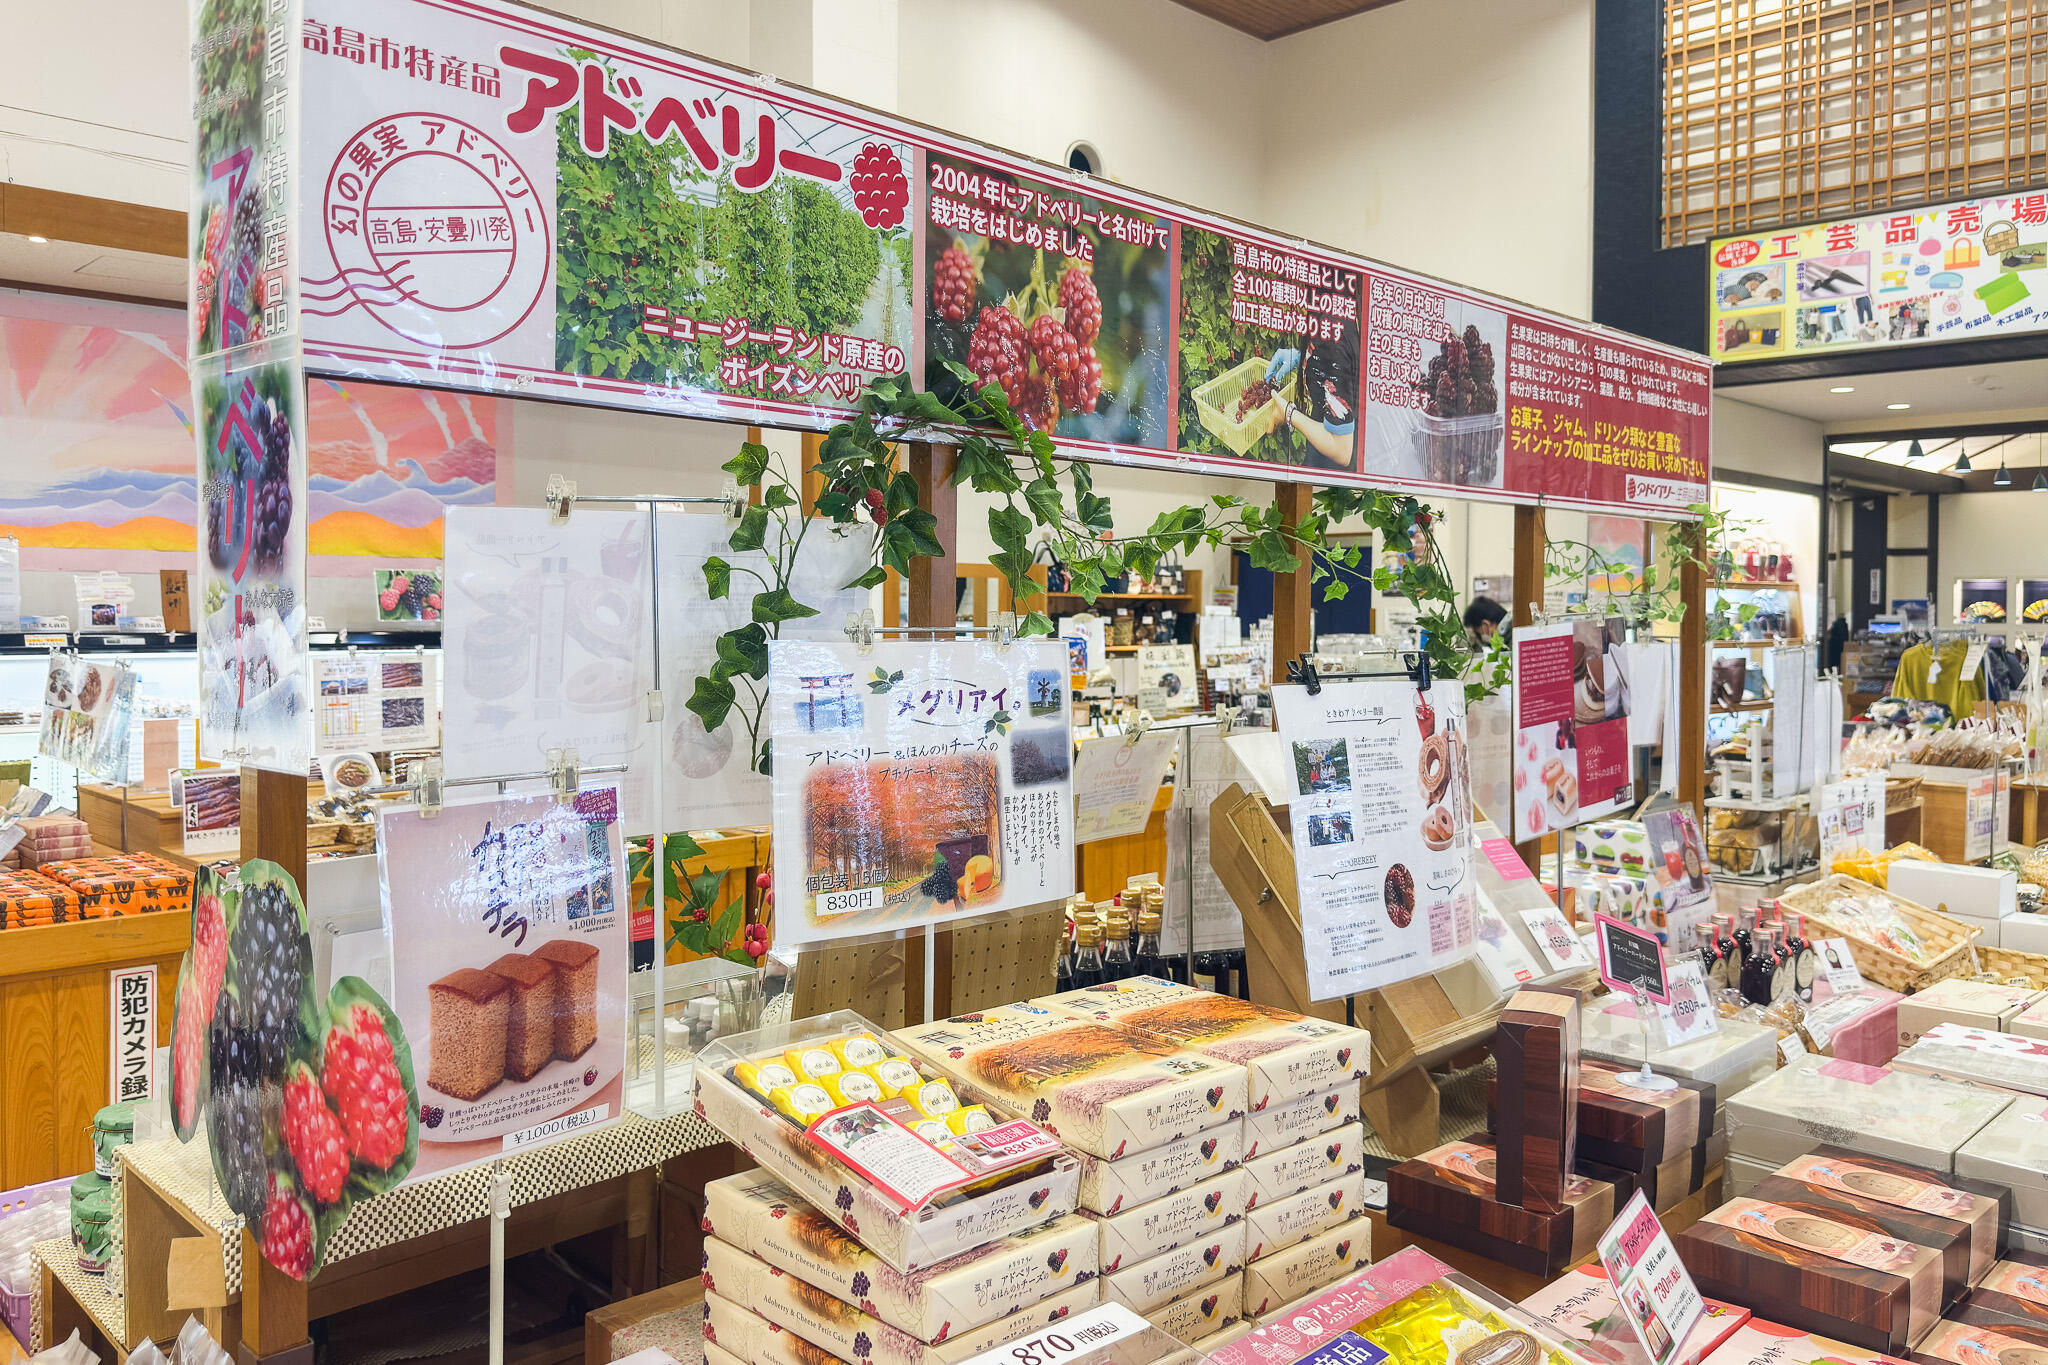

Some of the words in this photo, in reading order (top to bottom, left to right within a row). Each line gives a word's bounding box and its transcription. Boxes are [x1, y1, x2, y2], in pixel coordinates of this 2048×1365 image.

[303, 19, 502, 98] 高島市特産品
[498, 44, 843, 190] アドベリー
[331, 123, 408, 236] 幻の果実
[420, 120, 535, 233] アドベリー
[931, 164, 1169, 250] 2004年にアドベリーと名付けて
[931, 196, 1094, 261] 栽培をはじめました
[370, 216, 511, 245] 高島・安曇川発
[1233, 243, 1357, 293] 高島市の特産品として
[1232, 271, 1357, 320] 全100種類以上の認定
[1372, 279, 1446, 319] 毎年6月中旬頃
[642, 304, 906, 374] ニュージーランド原産の
[1231, 299, 1345, 342] 加工商品があります
[1370, 306, 1452, 343] 収穫の時期を迎え
[1370, 330, 1422, 360] 生の果実も
[1369, 355, 1422, 386] お買い求め
[1368, 382, 1431, 410] いただけます
[1511, 405, 1681, 453] お菓子、ジャム、ドリンク類など豊富な
[1511, 431, 1707, 479] ラインナップの加工品をぜひお買い求め下さい。
[898, 687, 1022, 716] メグリアイ。
[806, 747, 890, 766] アドベリー
[895, 736, 998, 761] &ほんのりチーズの
[879, 768, 938, 782] プチケーキ
[806, 874, 849, 892] 個包装
[827, 890, 873, 911] 830円
[883, 891, 911, 906] (税込)
[121, 975, 149, 1103] 防犯カメラ録
[762, 1237, 788, 1256] Adoberry
[795, 1254, 815, 1270] Cheese
[816, 1263, 831, 1277] Petit
[831, 1272, 847, 1286] Cake
[763, 1295, 789, 1314] Adoberry
[796, 1311, 817, 1329] Cheese
[818, 1323, 832, 1336] Petit
[833, 1331, 848, 1345] Cake
[1306, 1291, 1360, 1319] アドベリー
[1012, 1334, 1075, 1365] 870
